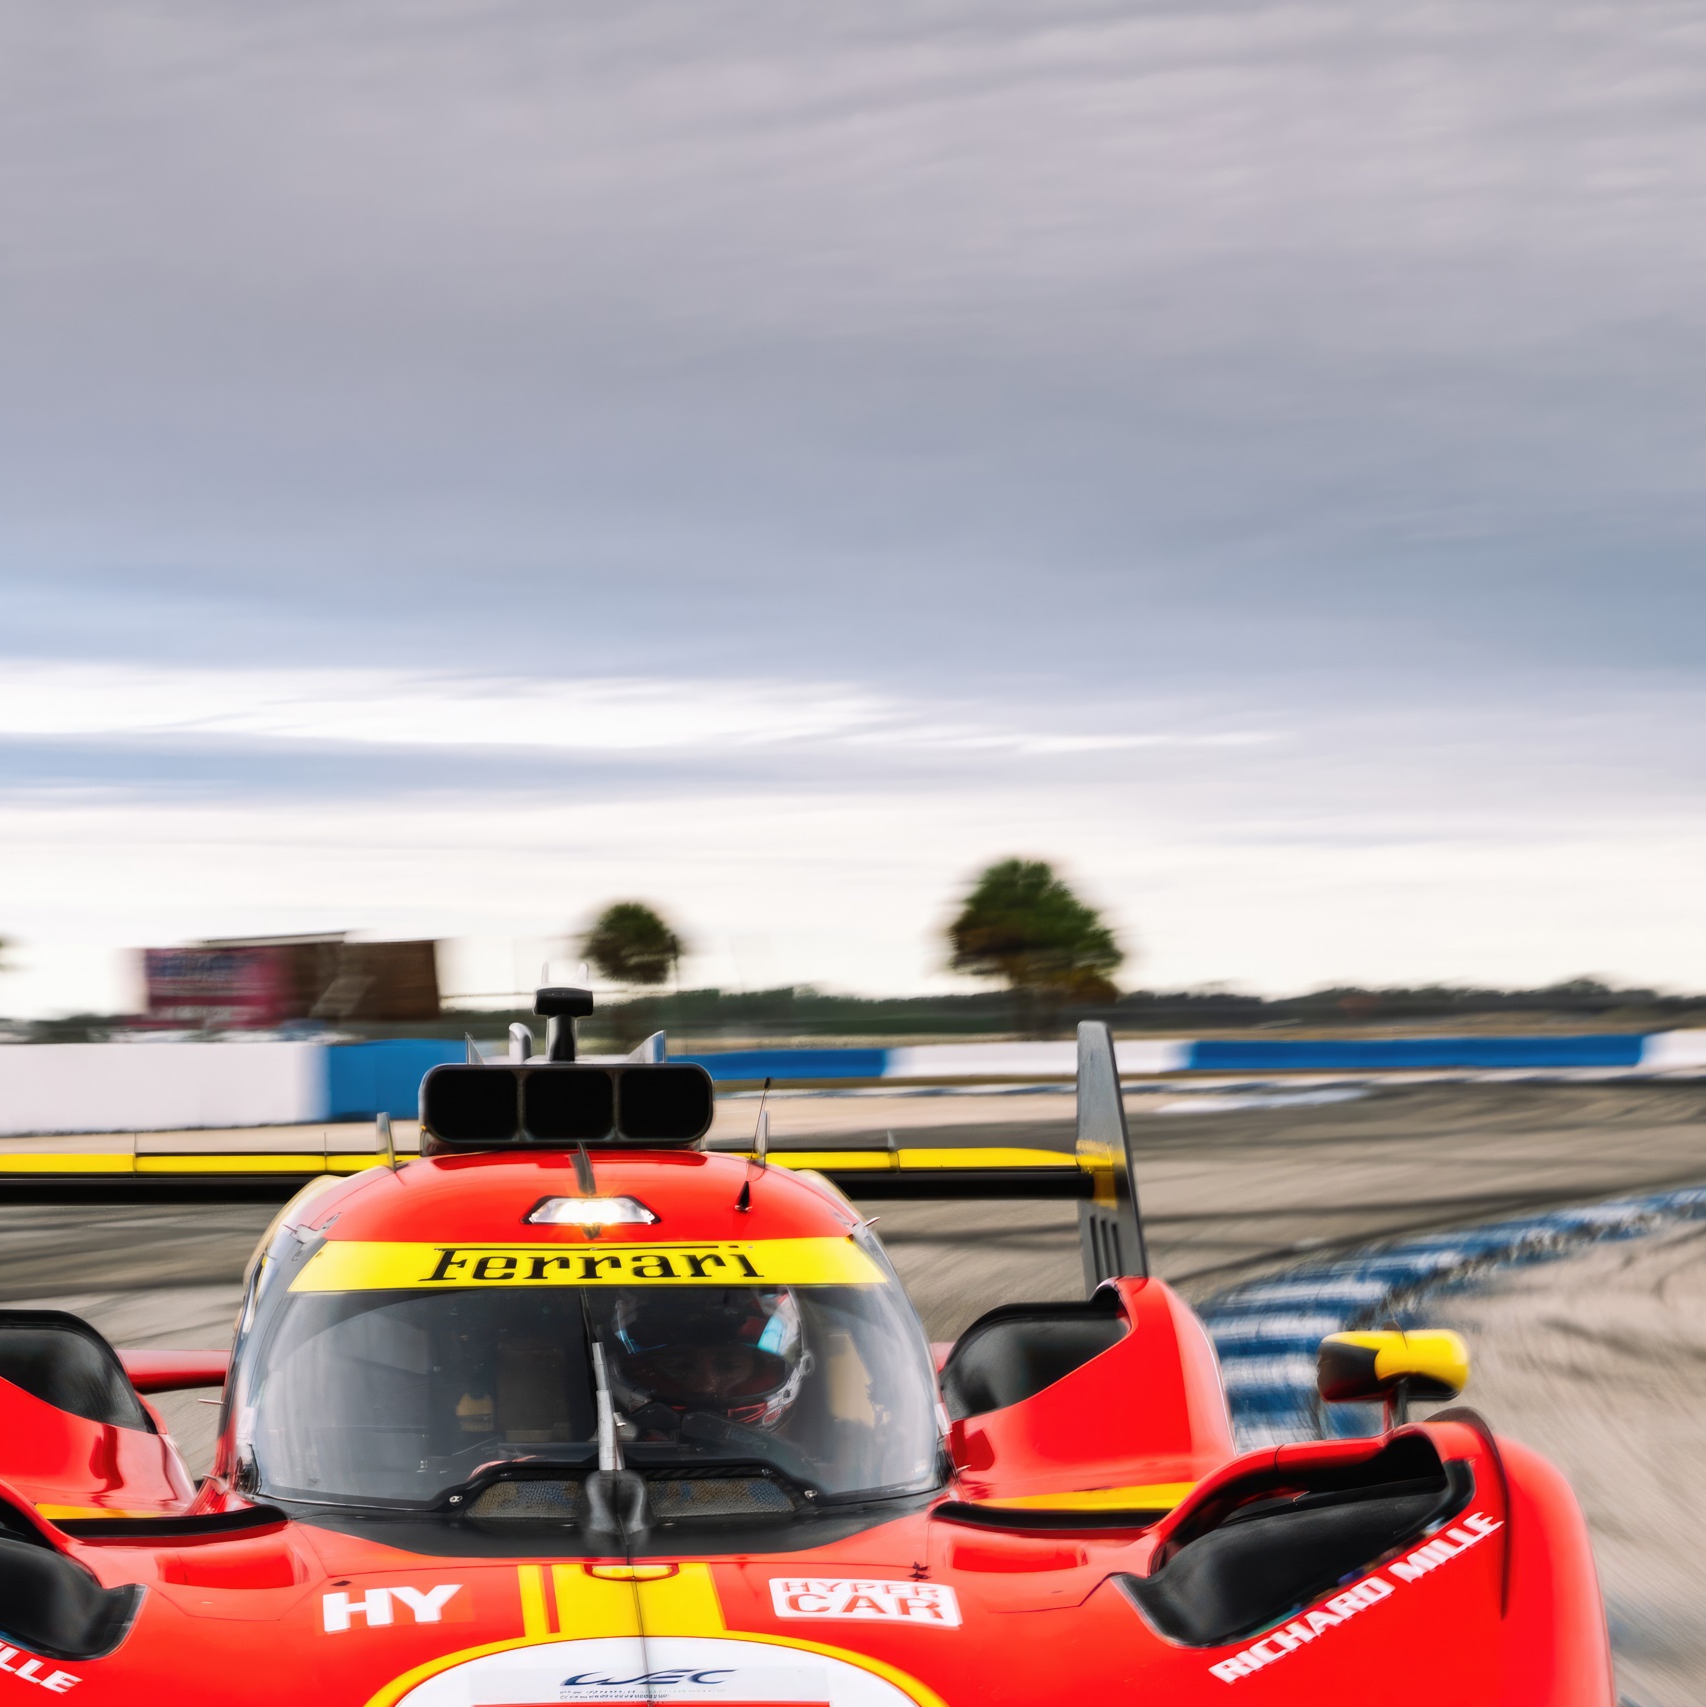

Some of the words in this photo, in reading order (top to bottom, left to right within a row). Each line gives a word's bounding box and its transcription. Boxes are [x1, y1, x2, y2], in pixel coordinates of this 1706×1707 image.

[417, 1245, 764, 1282] Ferrari
[782, 1581, 941, 1598] HYPER
[1208, 1576, 1395, 1685] RICHARD
[1388, 1511, 1504, 1583] MILLE
[321, 1584, 462, 1633] HY
[785, 1593, 943, 1620] CAR
[560, 1668, 739, 1687] WEC
